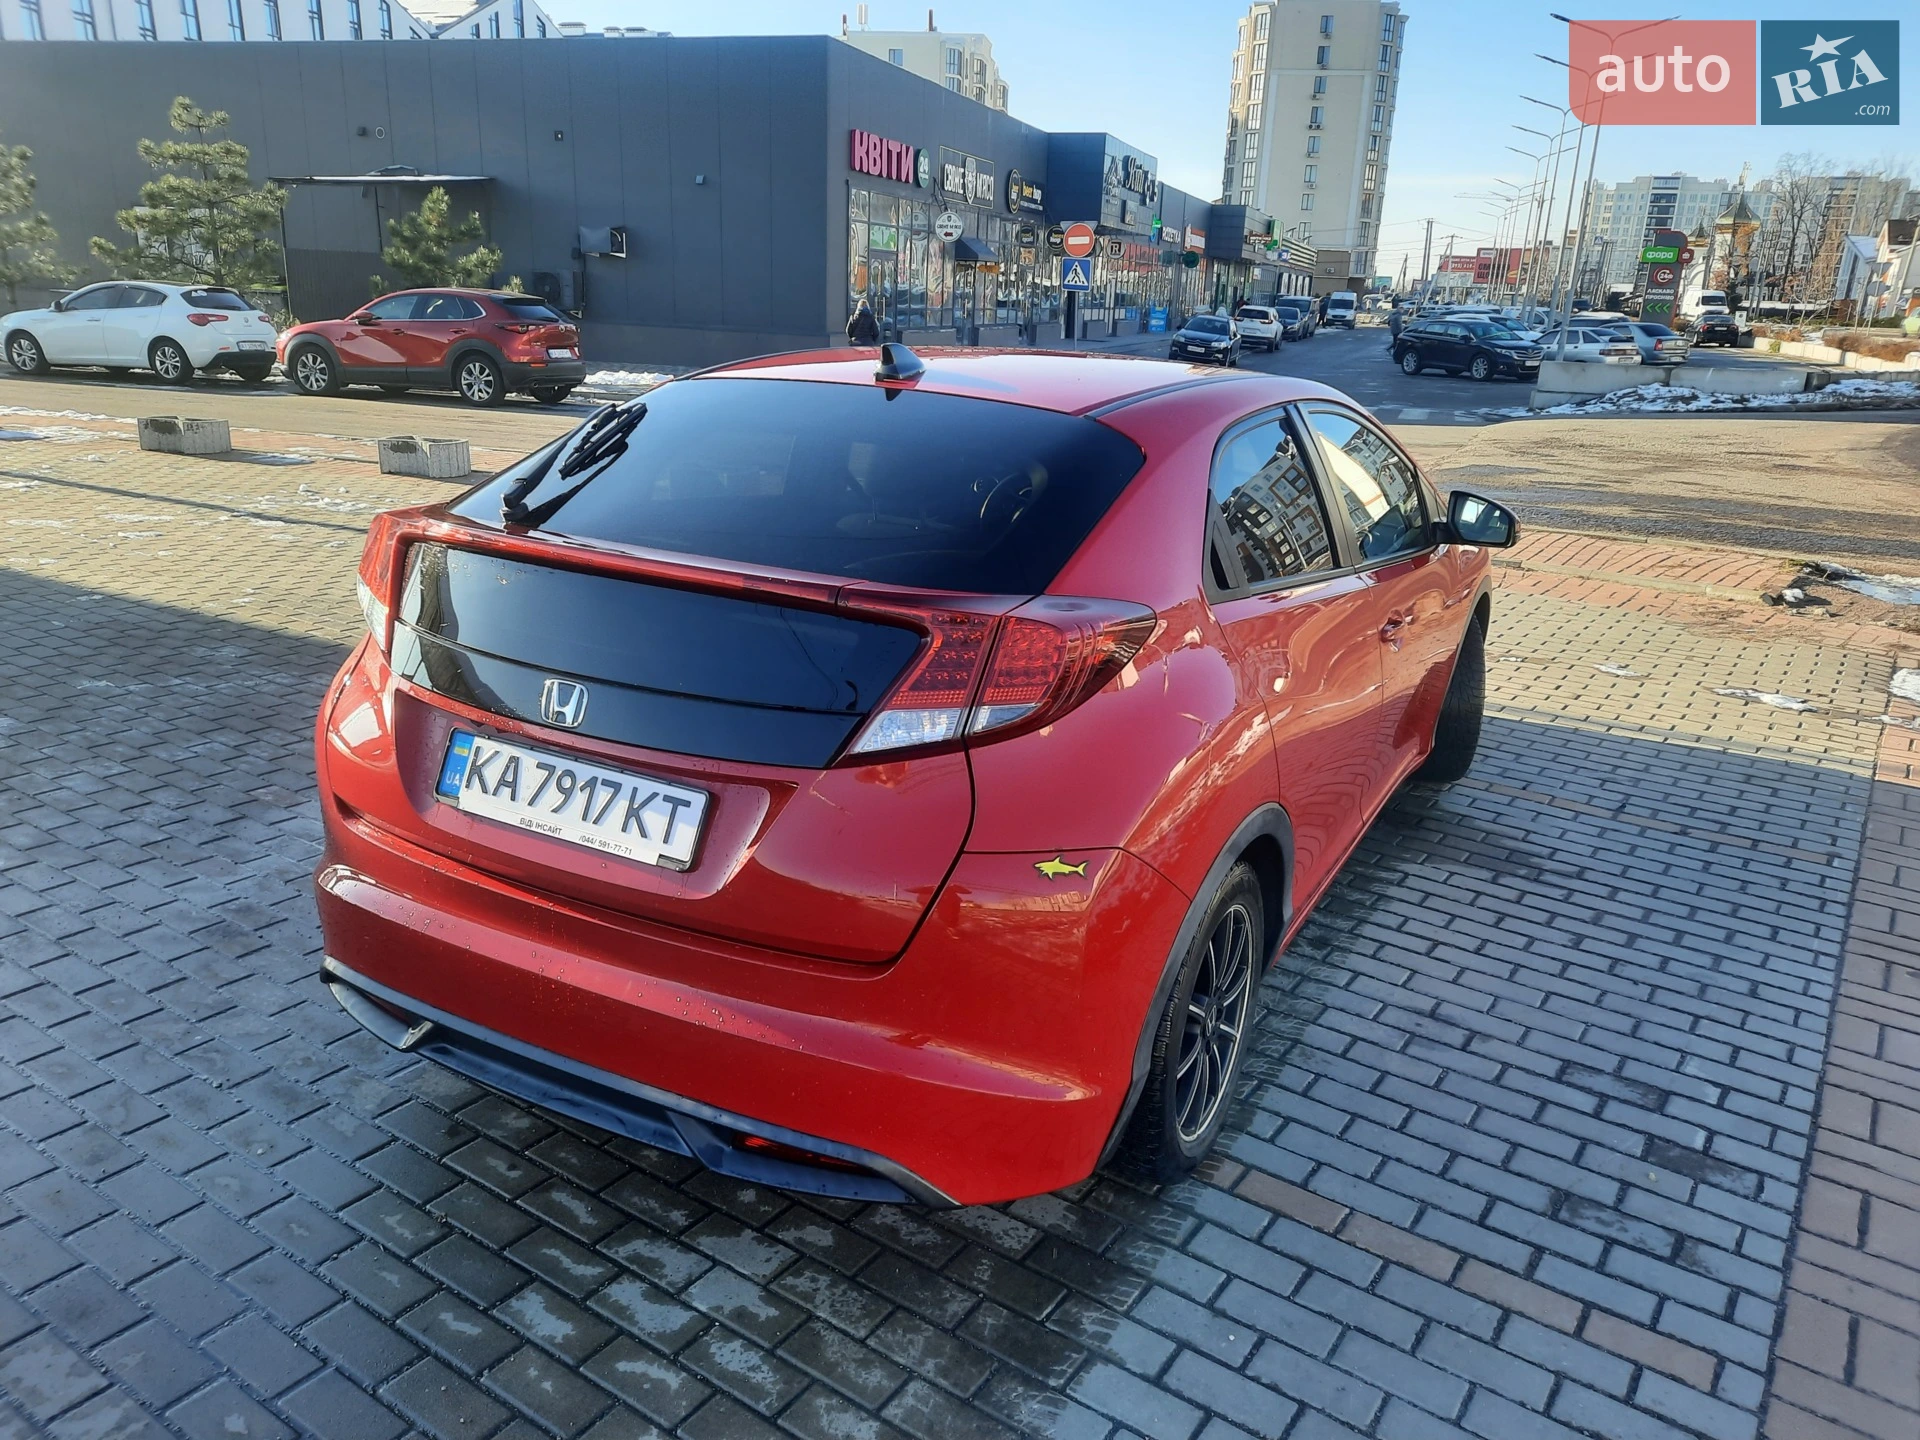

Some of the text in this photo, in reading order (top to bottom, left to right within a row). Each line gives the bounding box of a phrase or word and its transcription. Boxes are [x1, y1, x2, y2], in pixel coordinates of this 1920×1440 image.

[851, 129, 914, 184] КВІТИ
[919, 156, 929, 173] 24
[446, 770, 460, 787] UA
[534, 821, 563, 836] ІНСАЙТ
[578, 835, 598, 846] /044/
[597, 839, 633, 856] 591-77-71
